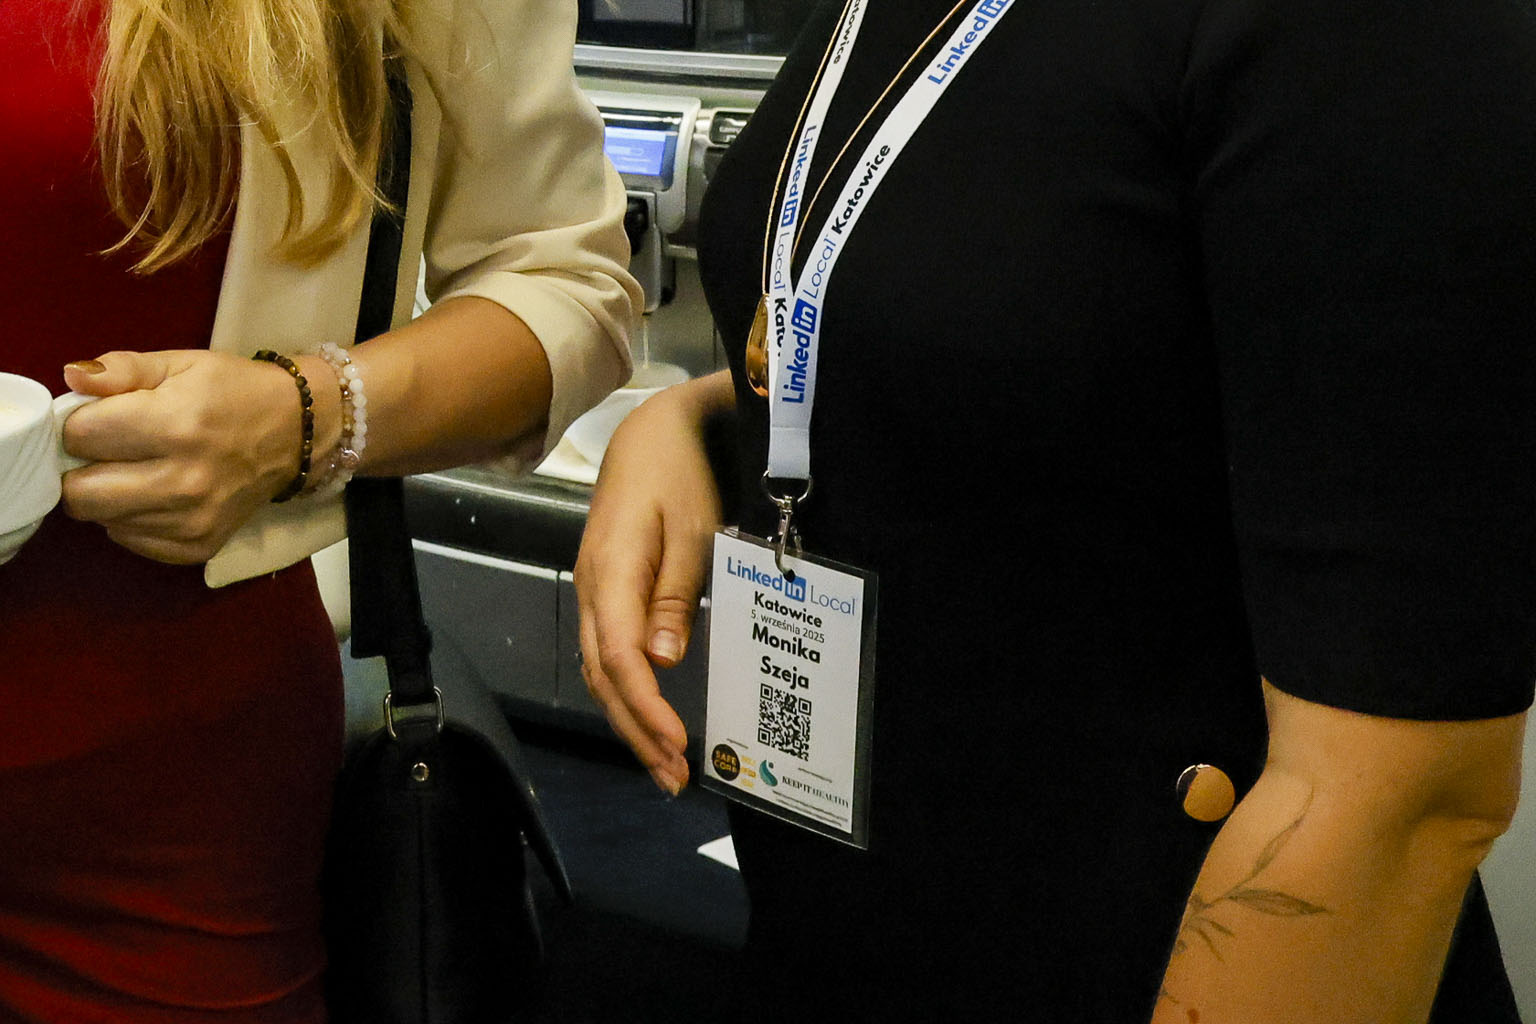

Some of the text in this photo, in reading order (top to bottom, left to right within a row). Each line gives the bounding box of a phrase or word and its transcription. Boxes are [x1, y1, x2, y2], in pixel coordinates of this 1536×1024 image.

[802, 237, 837, 299] Local
[831, 144, 891, 235] Katowice
[774, 232, 790, 290] Local
[754, 590, 823, 628] Katowice
[810, 585, 856, 616] Local
[752, 623, 821, 664] Monika
[760, 615, 801, 635] września
[802, 627, 825, 644] 2025
[760, 655, 810, 690] Szeja
